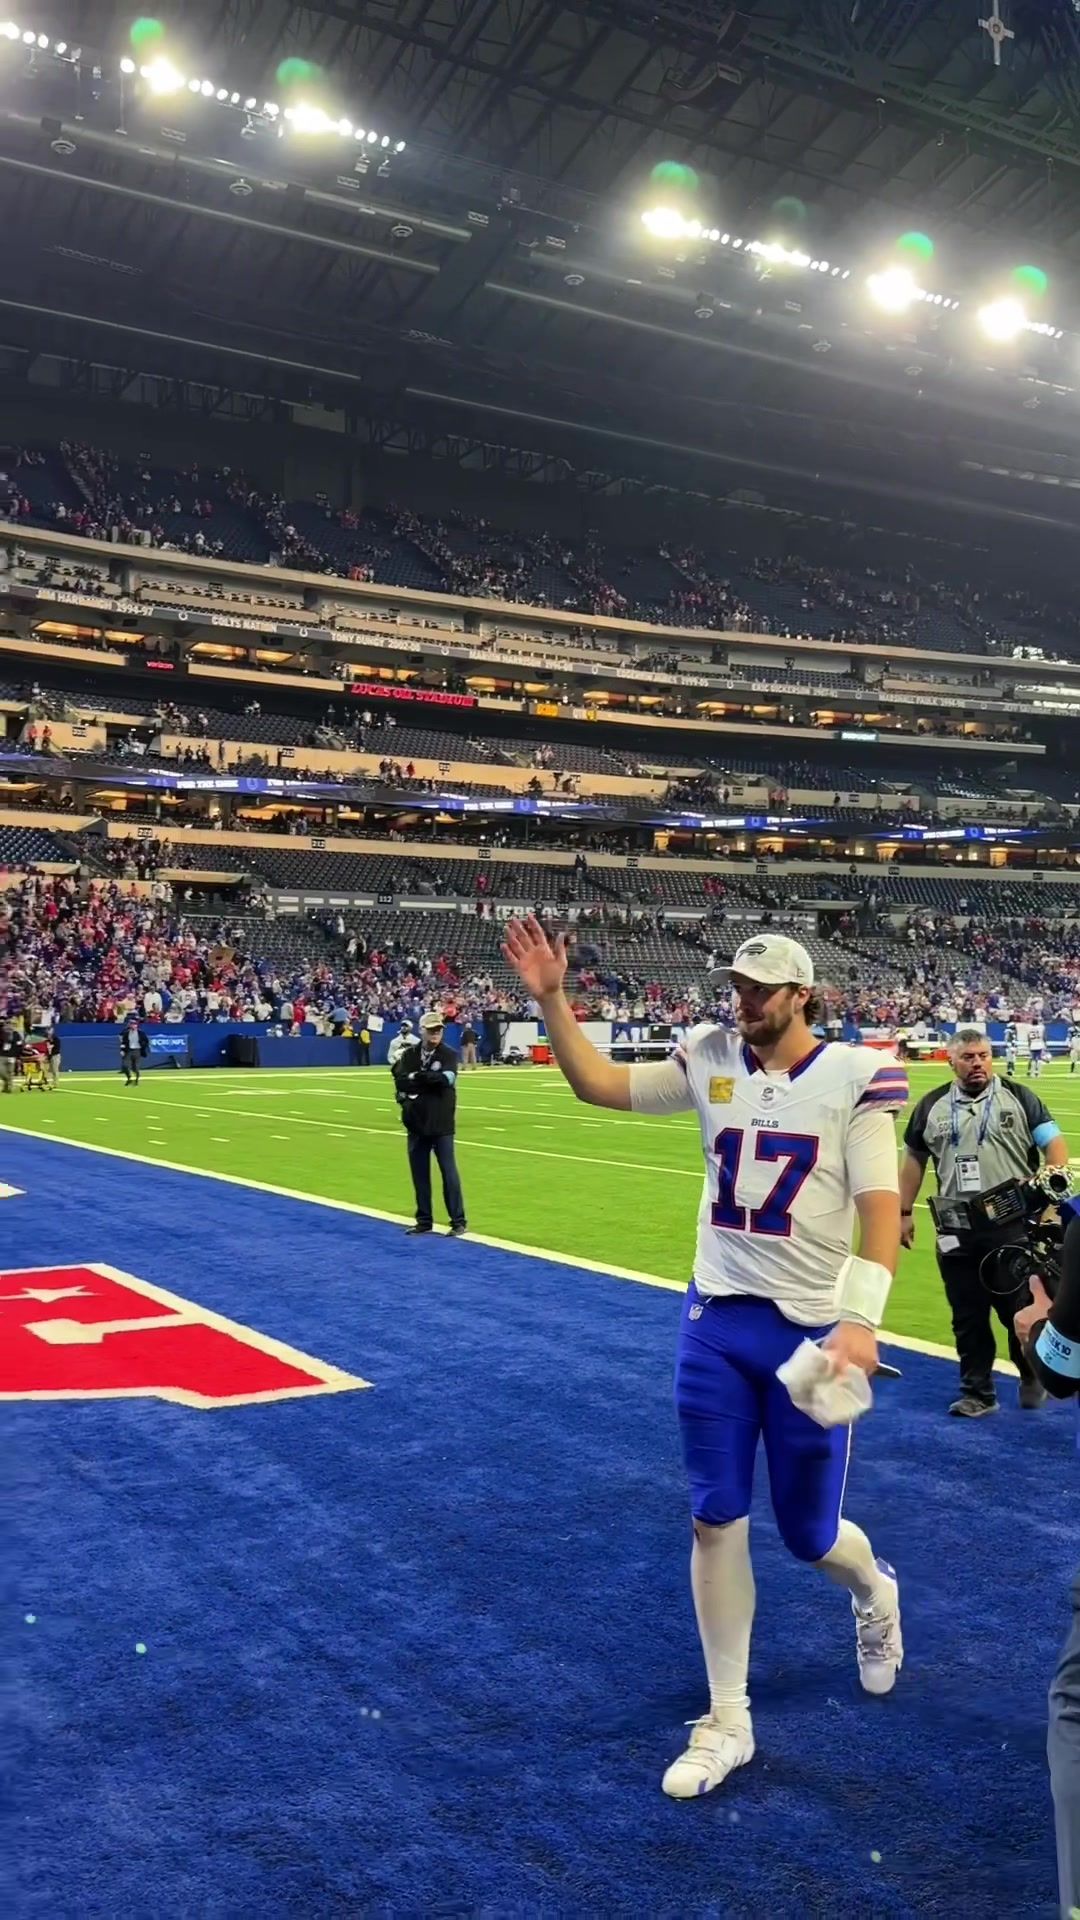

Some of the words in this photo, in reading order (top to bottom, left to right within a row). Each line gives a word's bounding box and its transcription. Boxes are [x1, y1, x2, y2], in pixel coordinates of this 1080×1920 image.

[351, 683, 392, 697] LUCAS
[378, 895, 393, 903] 112
[751, 1118, 779, 1129] BILLS
[711, 1127, 820, 1237] 17
[1061, 1344, 1072, 1356] 10
